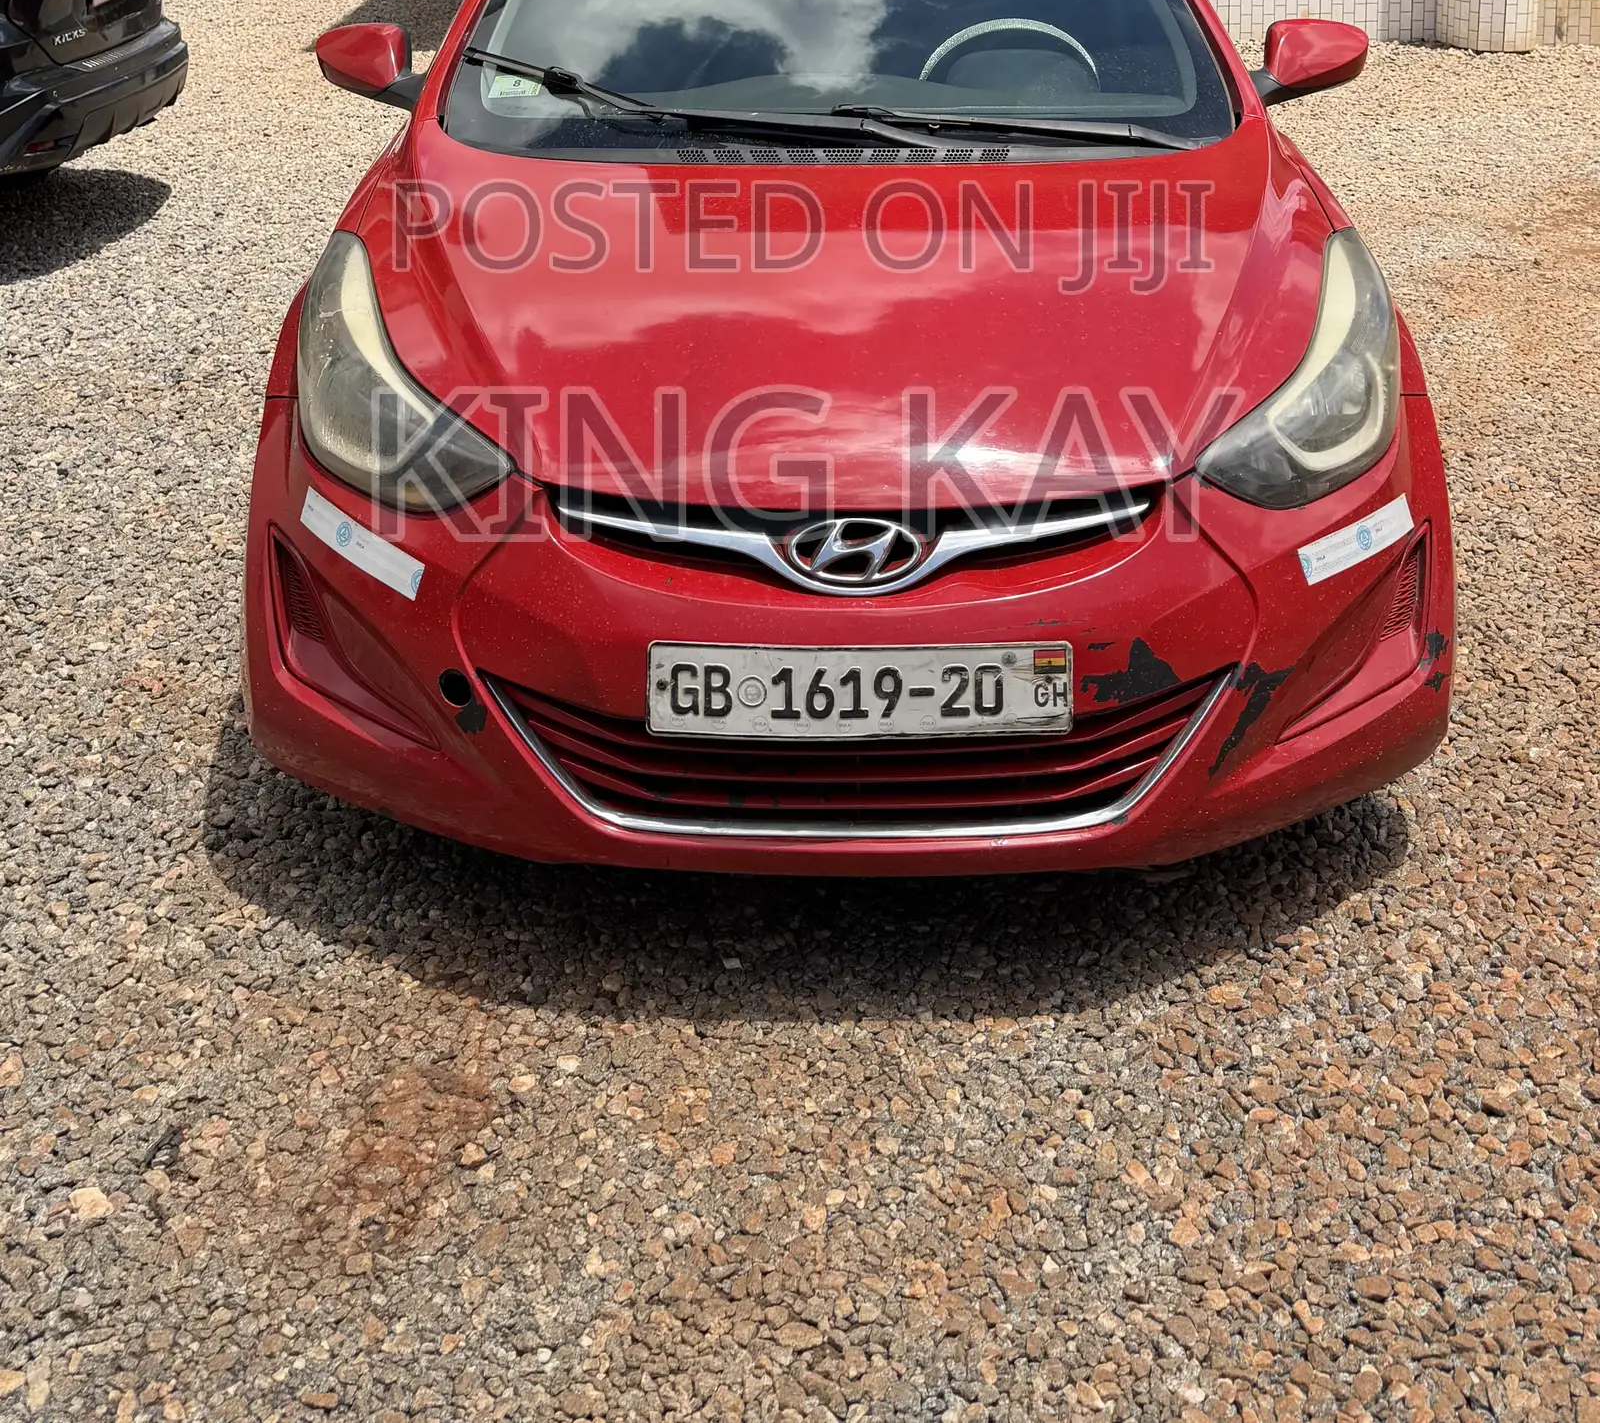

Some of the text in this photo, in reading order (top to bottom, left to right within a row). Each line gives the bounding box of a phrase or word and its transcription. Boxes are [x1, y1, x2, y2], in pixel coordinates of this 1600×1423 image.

[671, 662, 1004, 719] GB 1619-20
[1034, 681, 1068, 708] GH
